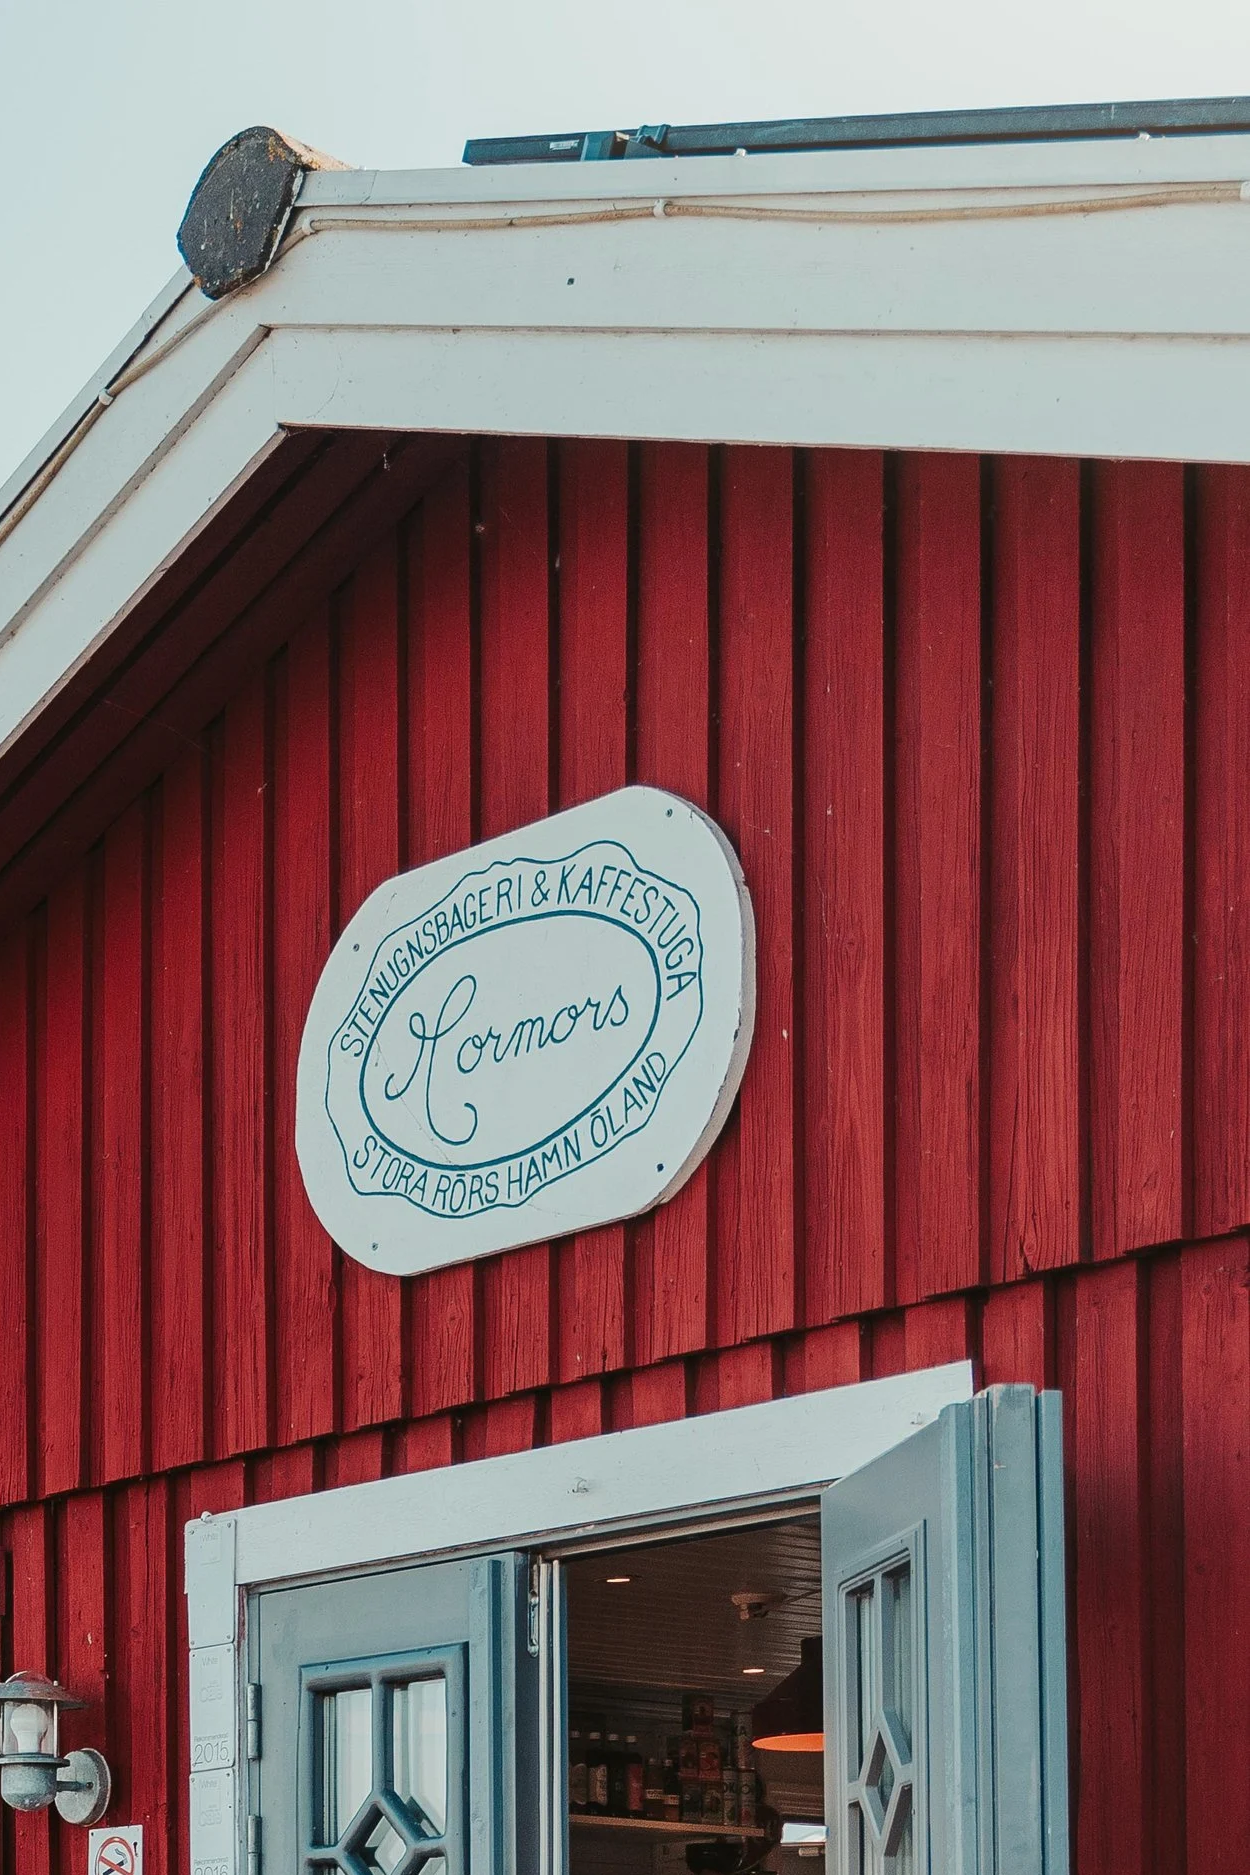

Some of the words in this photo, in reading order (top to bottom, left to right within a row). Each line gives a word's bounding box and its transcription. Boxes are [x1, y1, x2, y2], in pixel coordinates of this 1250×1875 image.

[340, 873, 523, 1058] STENUGNSBAGERI
[531, 870, 550, 907] &
[556, 864, 698, 1001] KAFFESTUGA
[353, 1134, 429, 1199] STORA
[507, 1128, 583, 1197] HAMN
[194, 1740, 230, 1766] 2015
